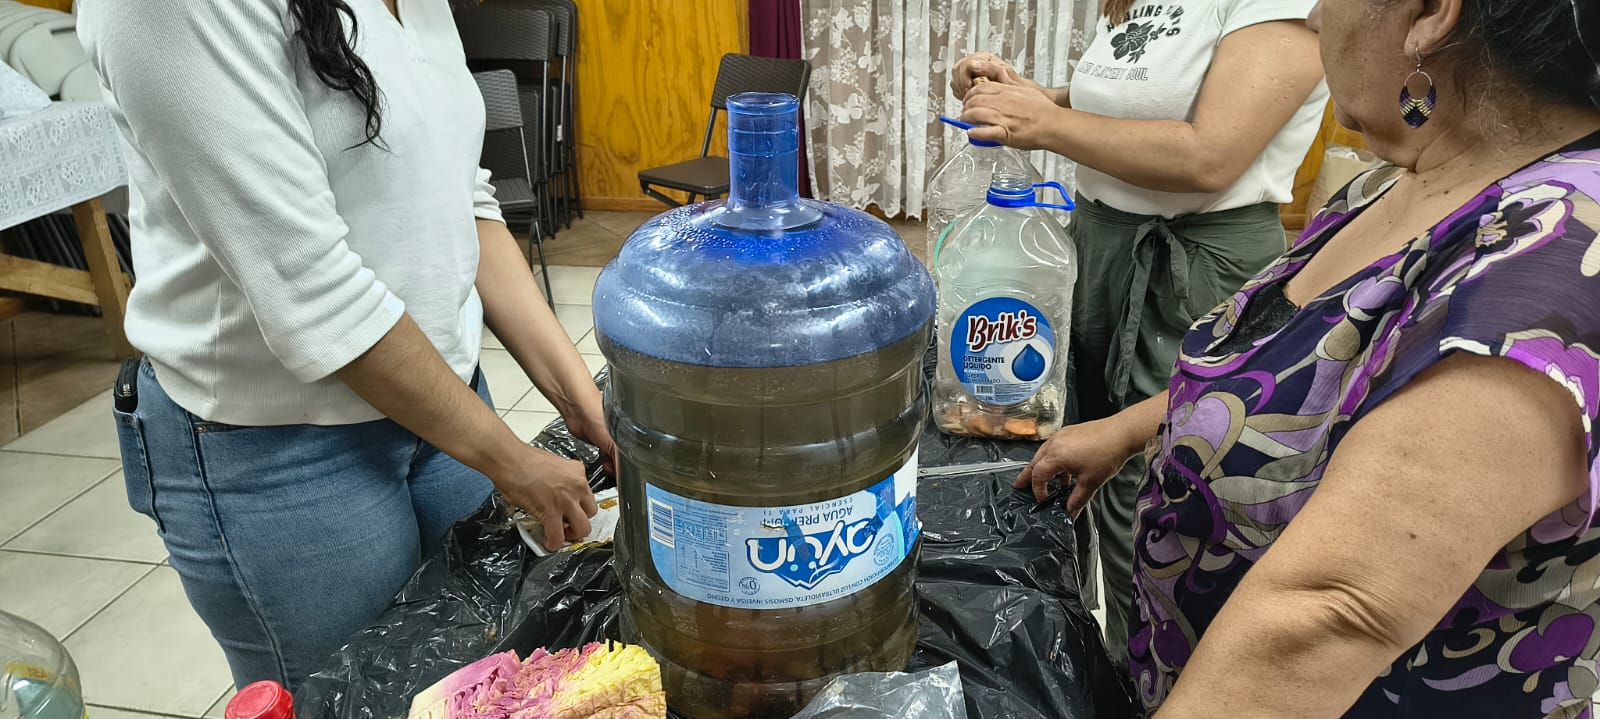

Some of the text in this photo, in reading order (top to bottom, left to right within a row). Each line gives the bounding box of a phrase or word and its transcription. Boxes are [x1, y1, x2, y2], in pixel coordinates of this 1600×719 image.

[1106, 4, 1163, 33] HALING
[967, 310, 1036, 351] Brik's
[963, 355, 1005, 363] DETERGENTE
[810, 496, 853, 512] ESENCIAL
[778, 505, 808, 514] PARA
[763, 505, 853, 526] AGUA PREUM
[852, 579, 863, 588] CON
[840, 585, 852, 593] LUZ
[707, 593, 730, 602] OZONO
